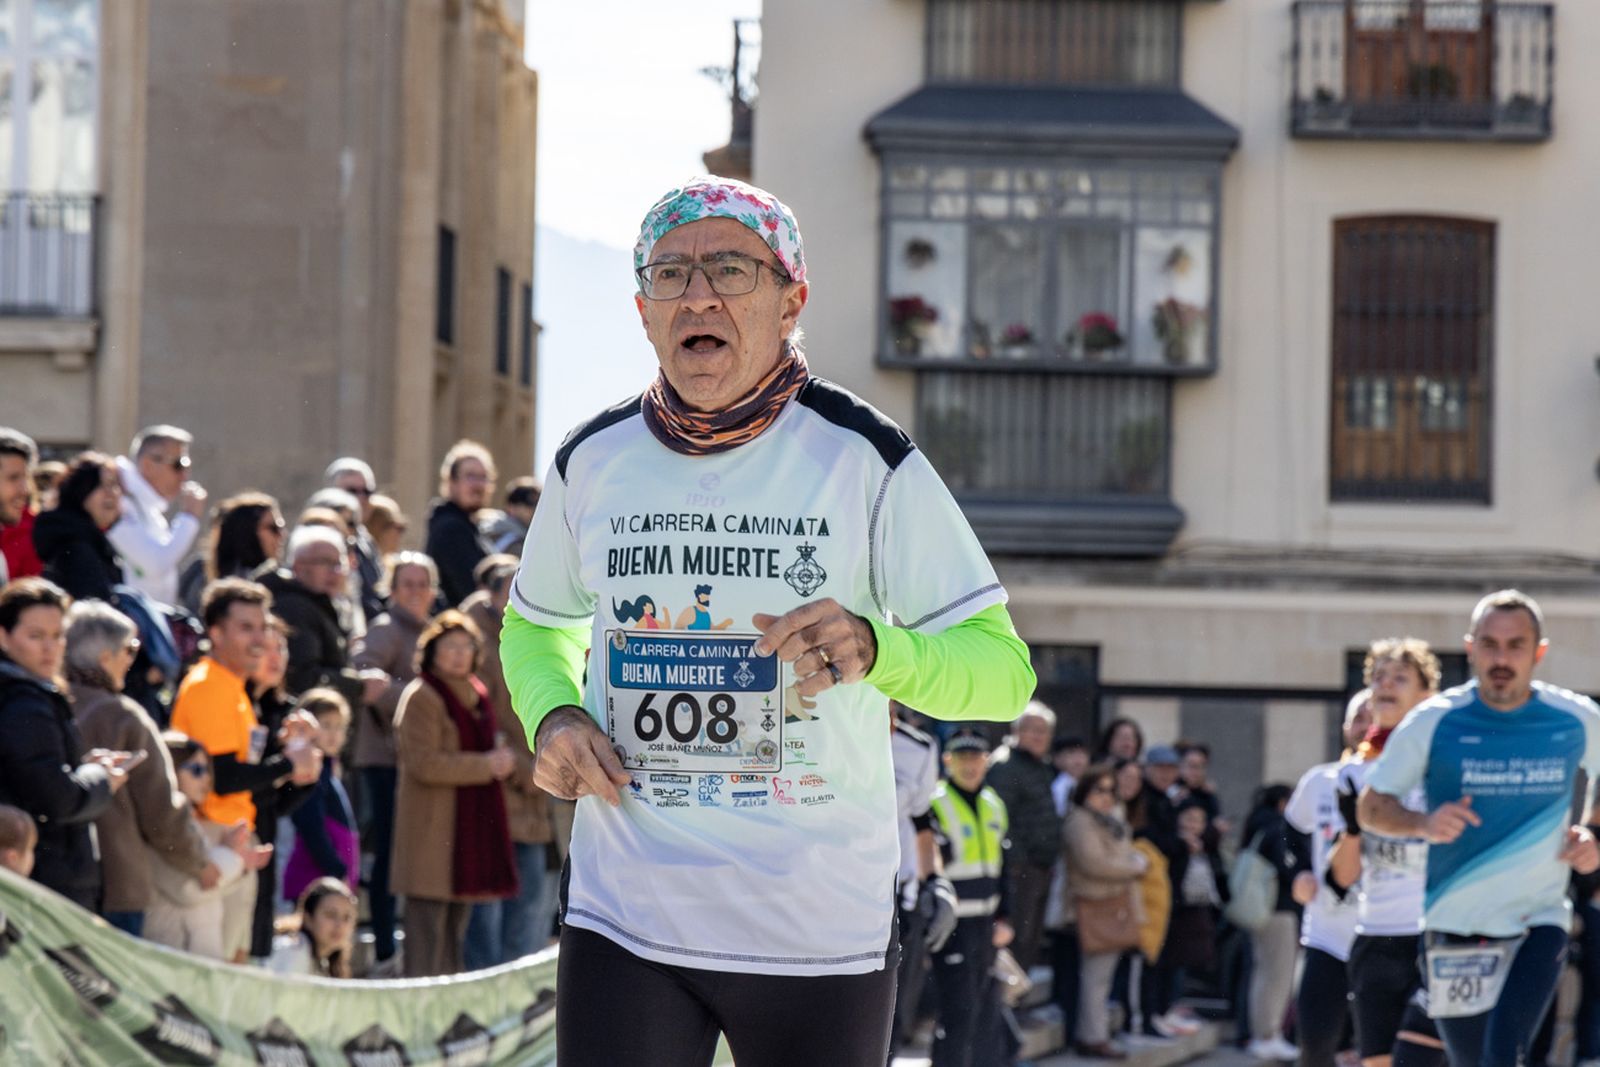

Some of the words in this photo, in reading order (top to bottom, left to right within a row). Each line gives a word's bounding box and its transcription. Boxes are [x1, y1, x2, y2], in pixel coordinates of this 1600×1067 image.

[610, 516, 624, 535] VI
[629, 513, 717, 533] CARRERA
[723, 514, 830, 537] CAMINATA
[607, 545, 674, 578] BUENA
[682, 545, 780, 578] MUERTE
[633, 643, 686, 657] CARRERA
[688, 645, 757, 658] CAMINATA
[622, 662, 662, 683] BUENA
[666, 664, 726, 685] MUERTE
[634, 692, 738, 744] 608
[647, 741, 664, 751] JOSÉ
[653, 788, 689, 797] BYD
